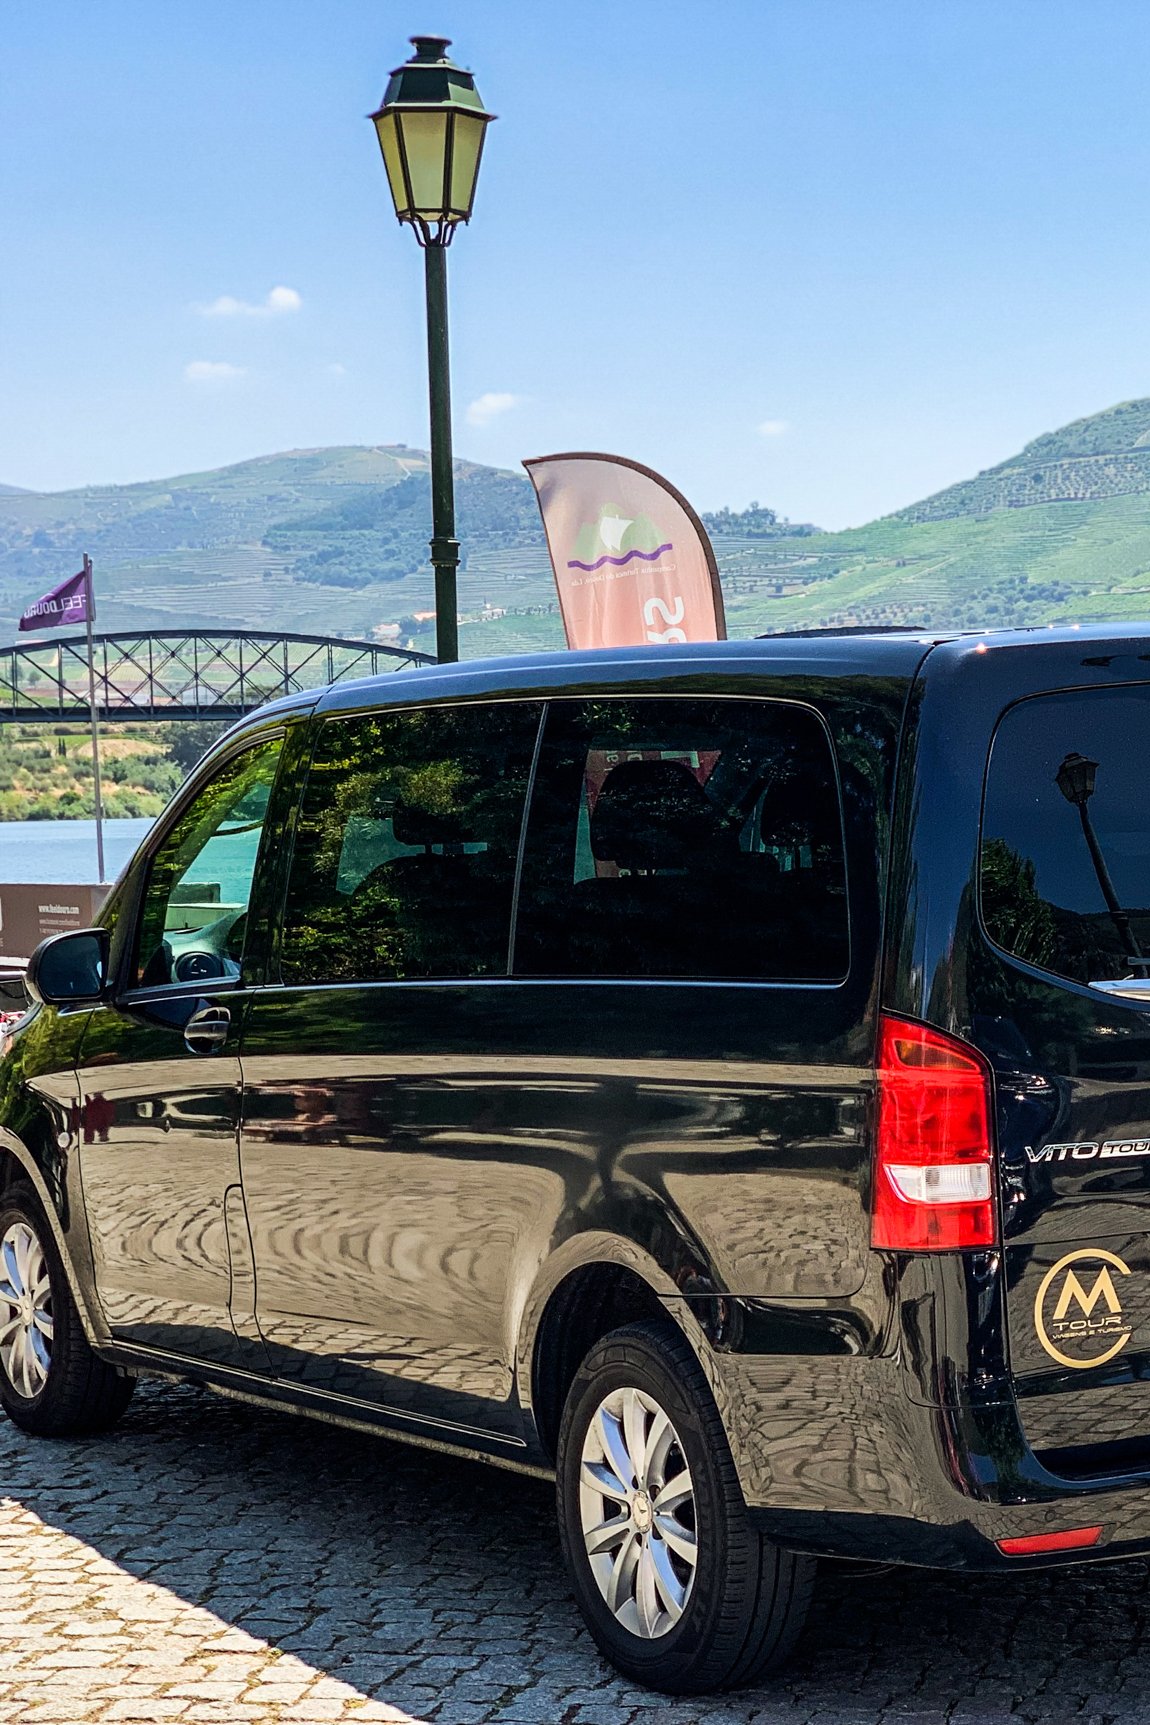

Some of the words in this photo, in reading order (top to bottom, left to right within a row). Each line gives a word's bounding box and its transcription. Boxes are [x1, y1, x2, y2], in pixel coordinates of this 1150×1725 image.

[1024, 1142, 1100, 1163] VITO
[1052, 1316, 1122, 1331] TOUR
[1098, 1325, 1133, 1335] TURISMO
